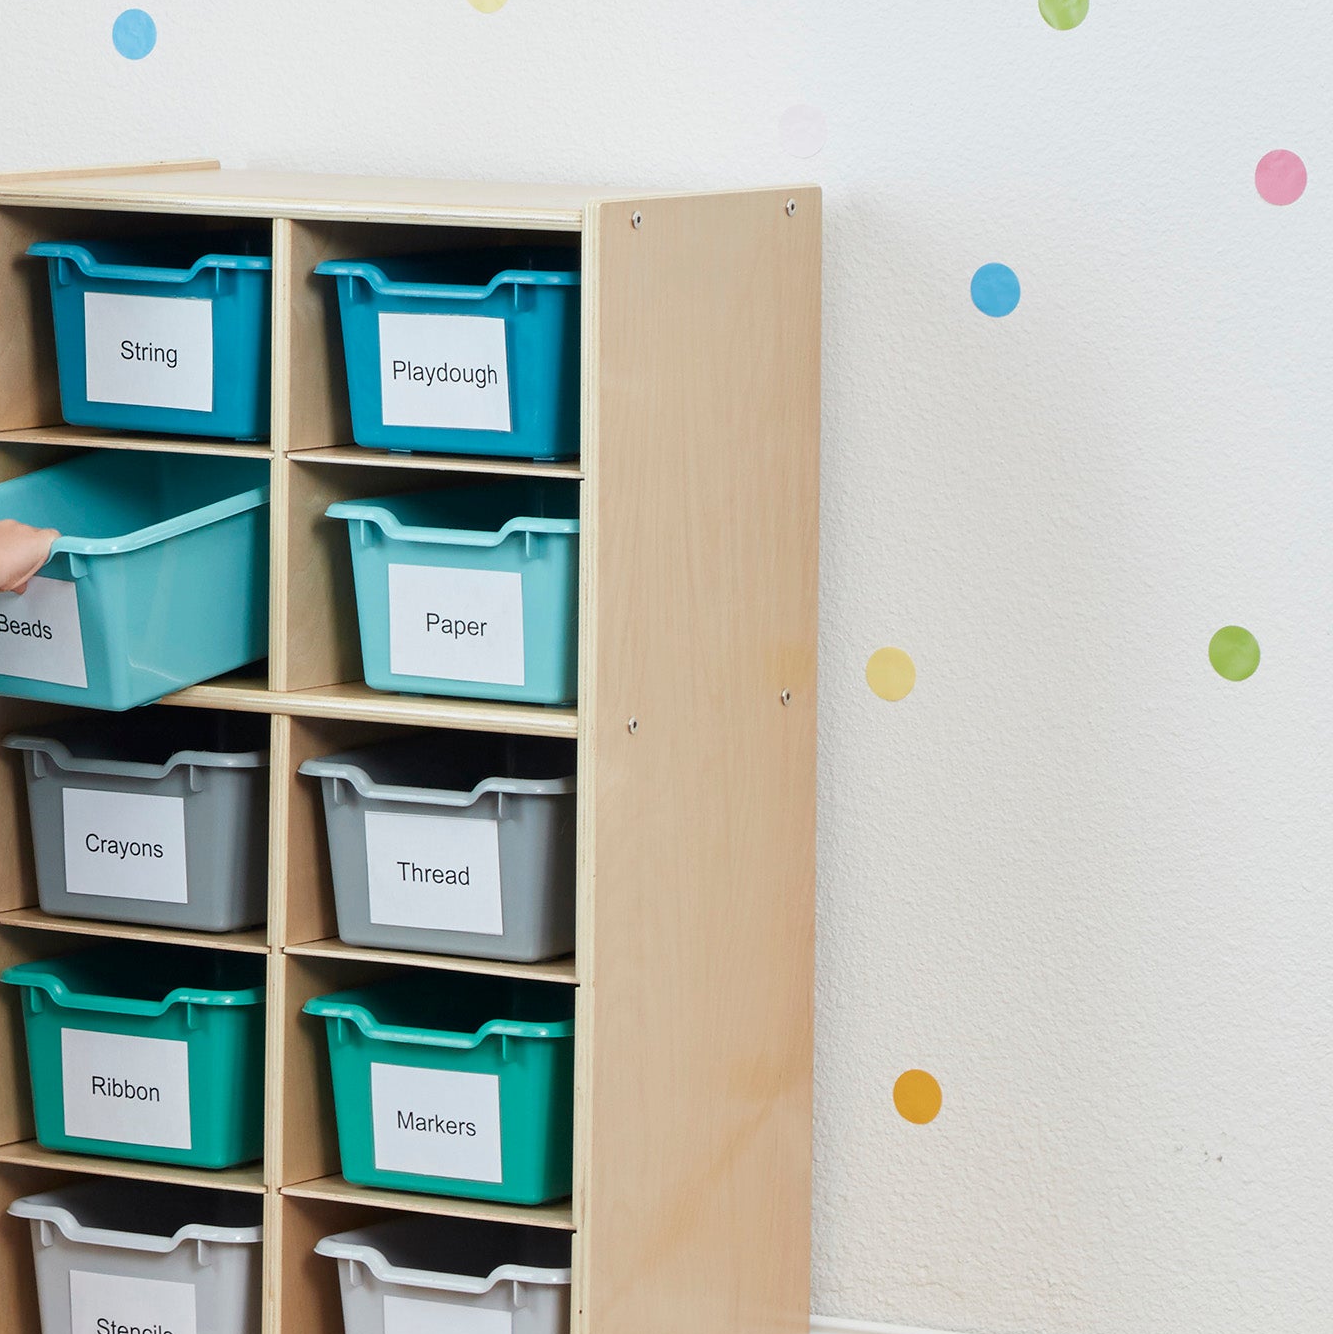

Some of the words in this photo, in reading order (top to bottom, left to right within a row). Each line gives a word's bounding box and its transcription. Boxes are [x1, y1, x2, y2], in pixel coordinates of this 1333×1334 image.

[120, 339, 178, 369] String
[393, 360, 498, 388] Playdough
[426, 612, 488, 639] Paper
[85, 833, 164, 860] Crayons
[397, 861, 470, 886] Thread
[91, 1075, 160, 1103] Ribbon
[397, 1110, 477, 1137] Markers
